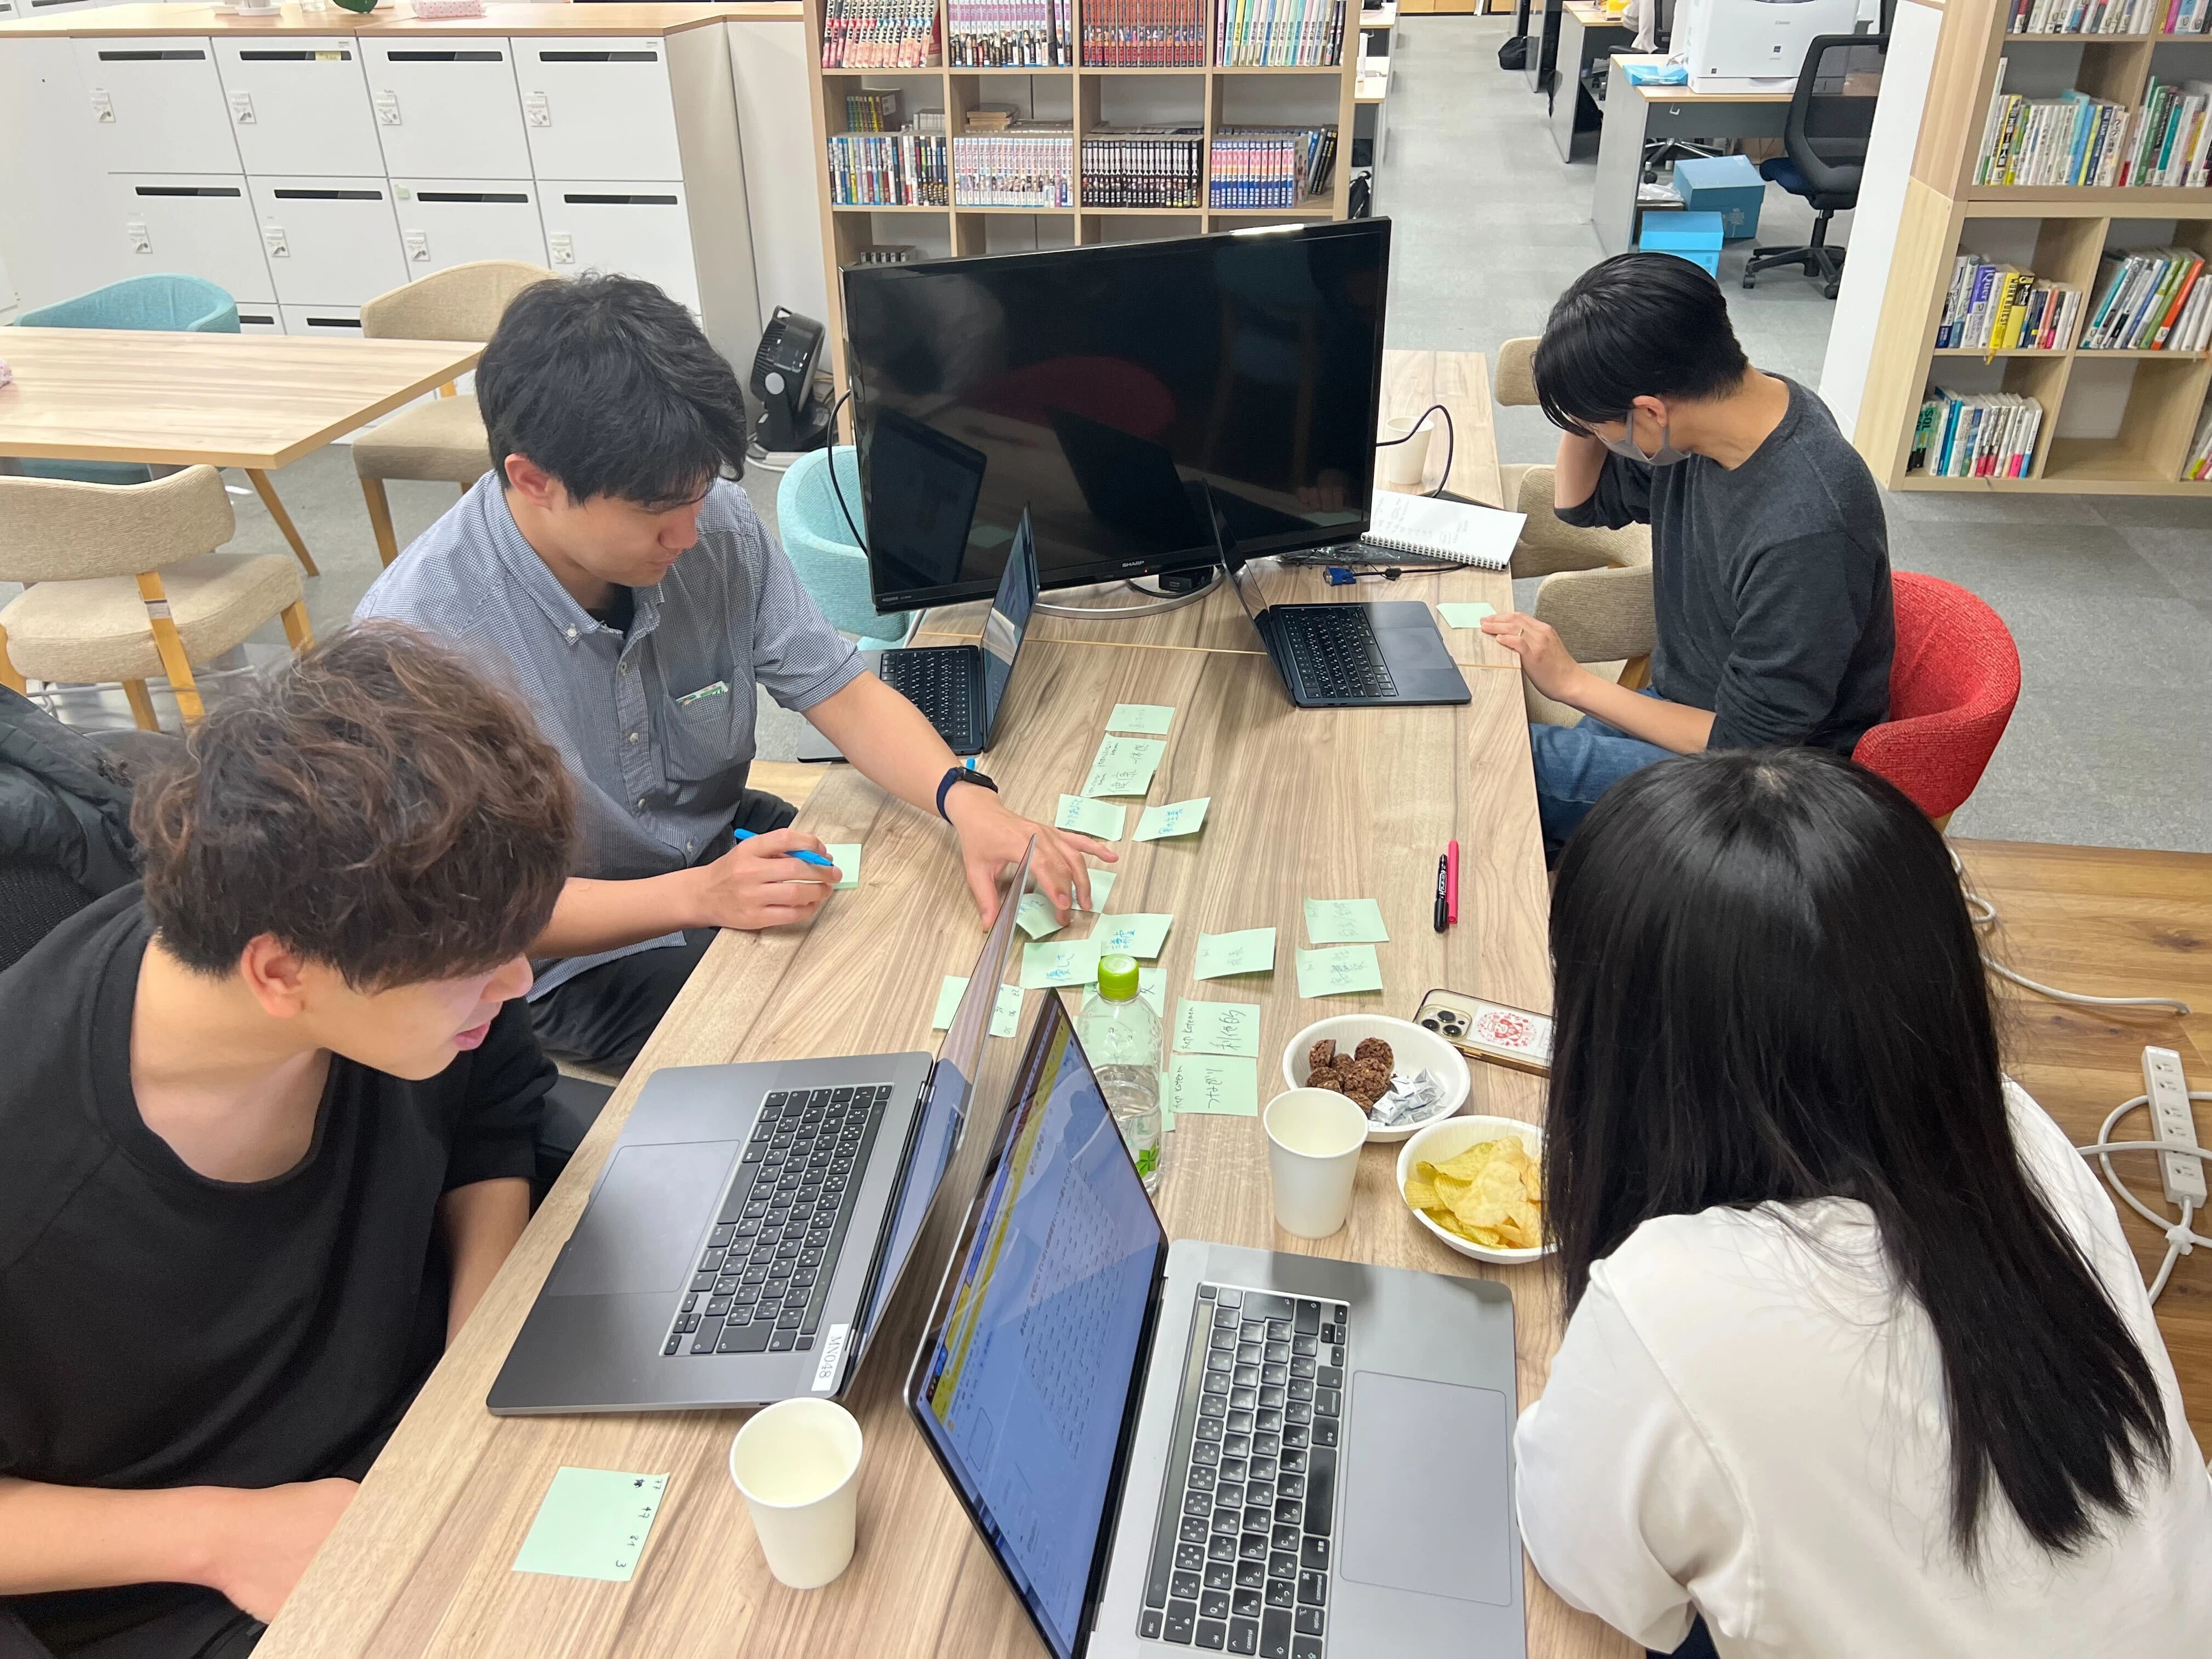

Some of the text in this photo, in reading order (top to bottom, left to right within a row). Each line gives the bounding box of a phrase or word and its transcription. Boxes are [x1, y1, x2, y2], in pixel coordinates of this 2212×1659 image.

[1922, 408, 1934, 431] SQL
[1205, 1069, 1223, 1108] つながり
[819, 1336, 842, 1379] MN048
[653, 1478, 663, 1490] 77
[638, 1506, 651, 1519] 47
